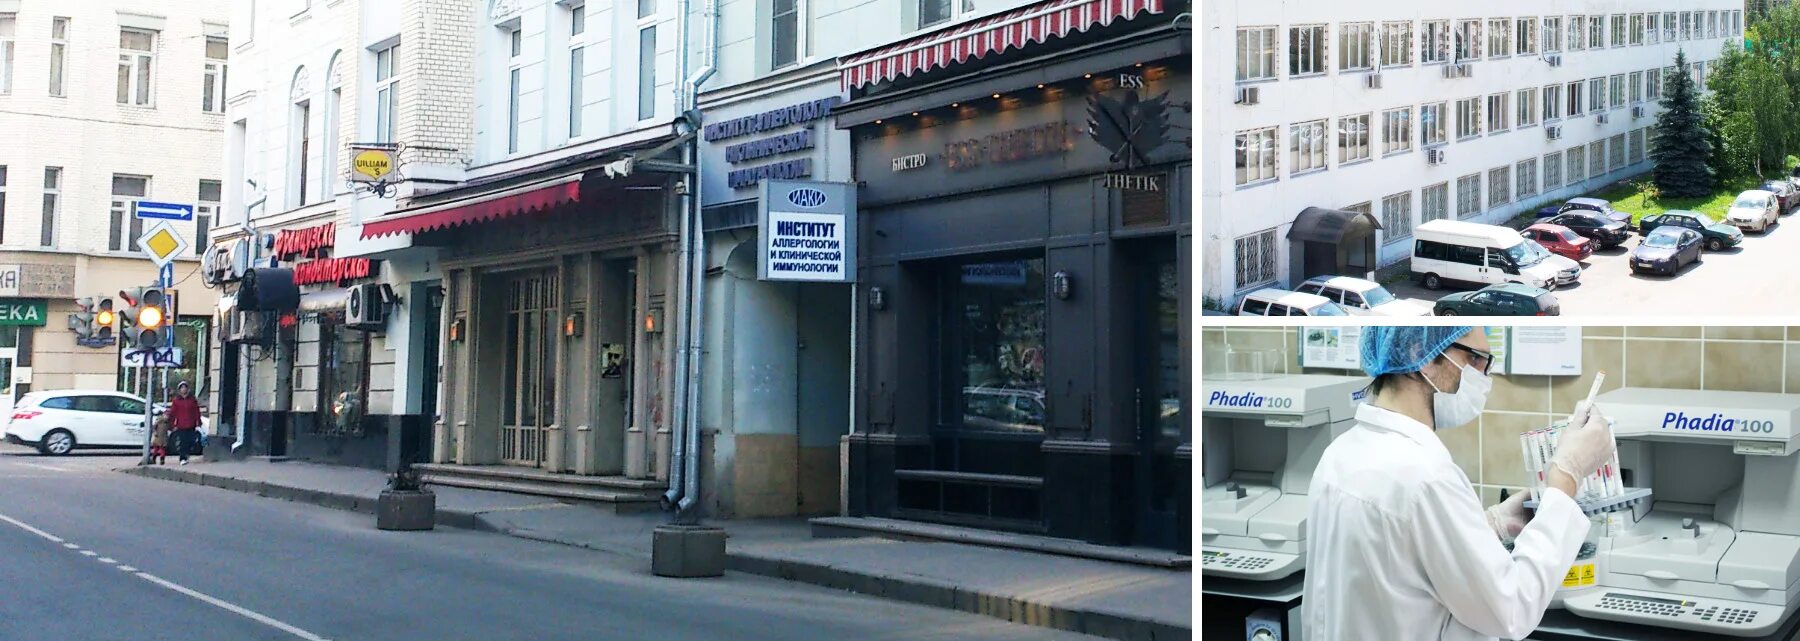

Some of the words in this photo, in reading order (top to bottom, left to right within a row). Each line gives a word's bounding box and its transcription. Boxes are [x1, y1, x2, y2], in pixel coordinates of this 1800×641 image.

[1120, 73, 1144, 88] ESS
[892, 153, 926, 171] БИСТРО
[791, 188, 824, 207] ИАКИ
[777, 220, 836, 238] ИНСТИТУТ
[772, 238, 840, 250] АЛЛЕРГОЛОГИИ
[770, 250, 777, 260] И
[779, 250, 842, 262] КЛИНИЧЕСКОЙ
[773, 261, 839, 273] ИММУНОЛОГИИ
[1209, 391, 1264, 408] Phadia
[1267, 396, 1292, 409] 100
[1661, 411, 1735, 432] Phadia
[1740, 419, 1774, 434] 100
